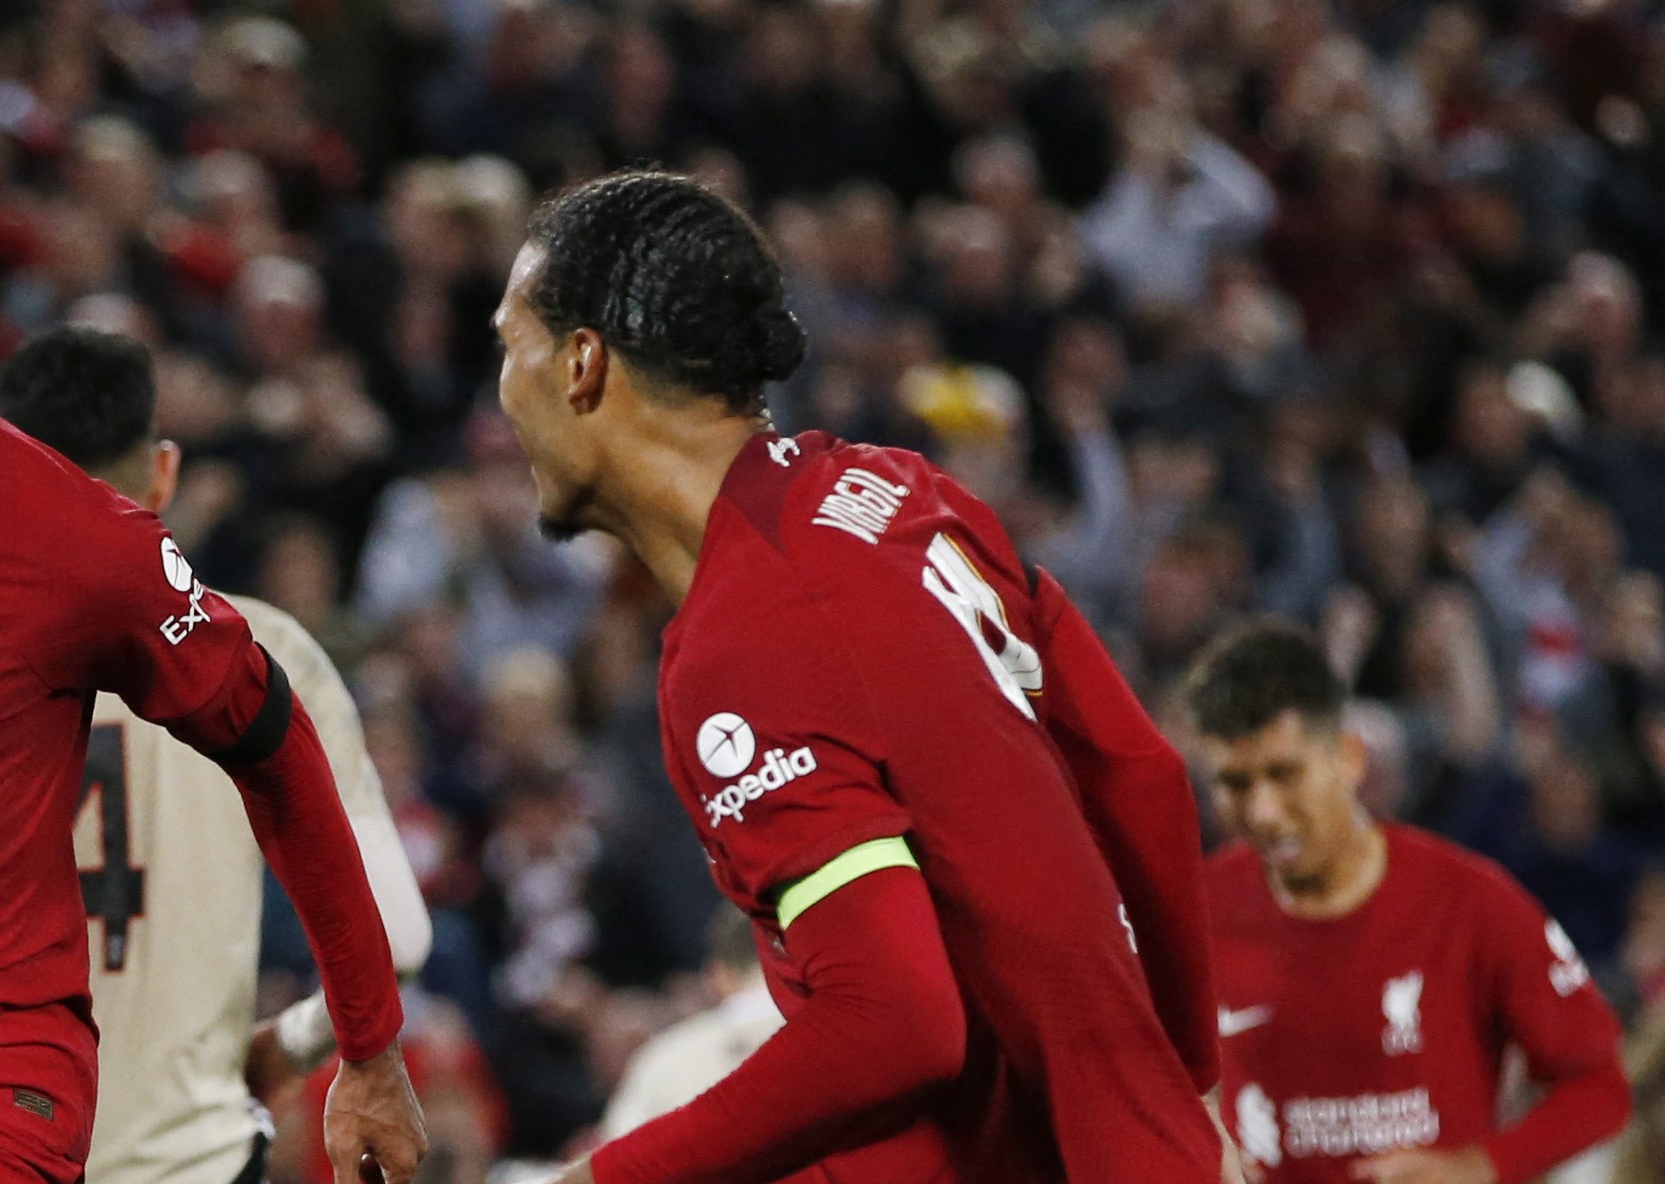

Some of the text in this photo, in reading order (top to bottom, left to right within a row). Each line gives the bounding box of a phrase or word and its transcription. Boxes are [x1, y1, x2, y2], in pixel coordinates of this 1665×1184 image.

[811, 467, 910, 545] VIRGIL
[700, 746, 817, 828] xpedia
[73, 717, 146, 973] 4
